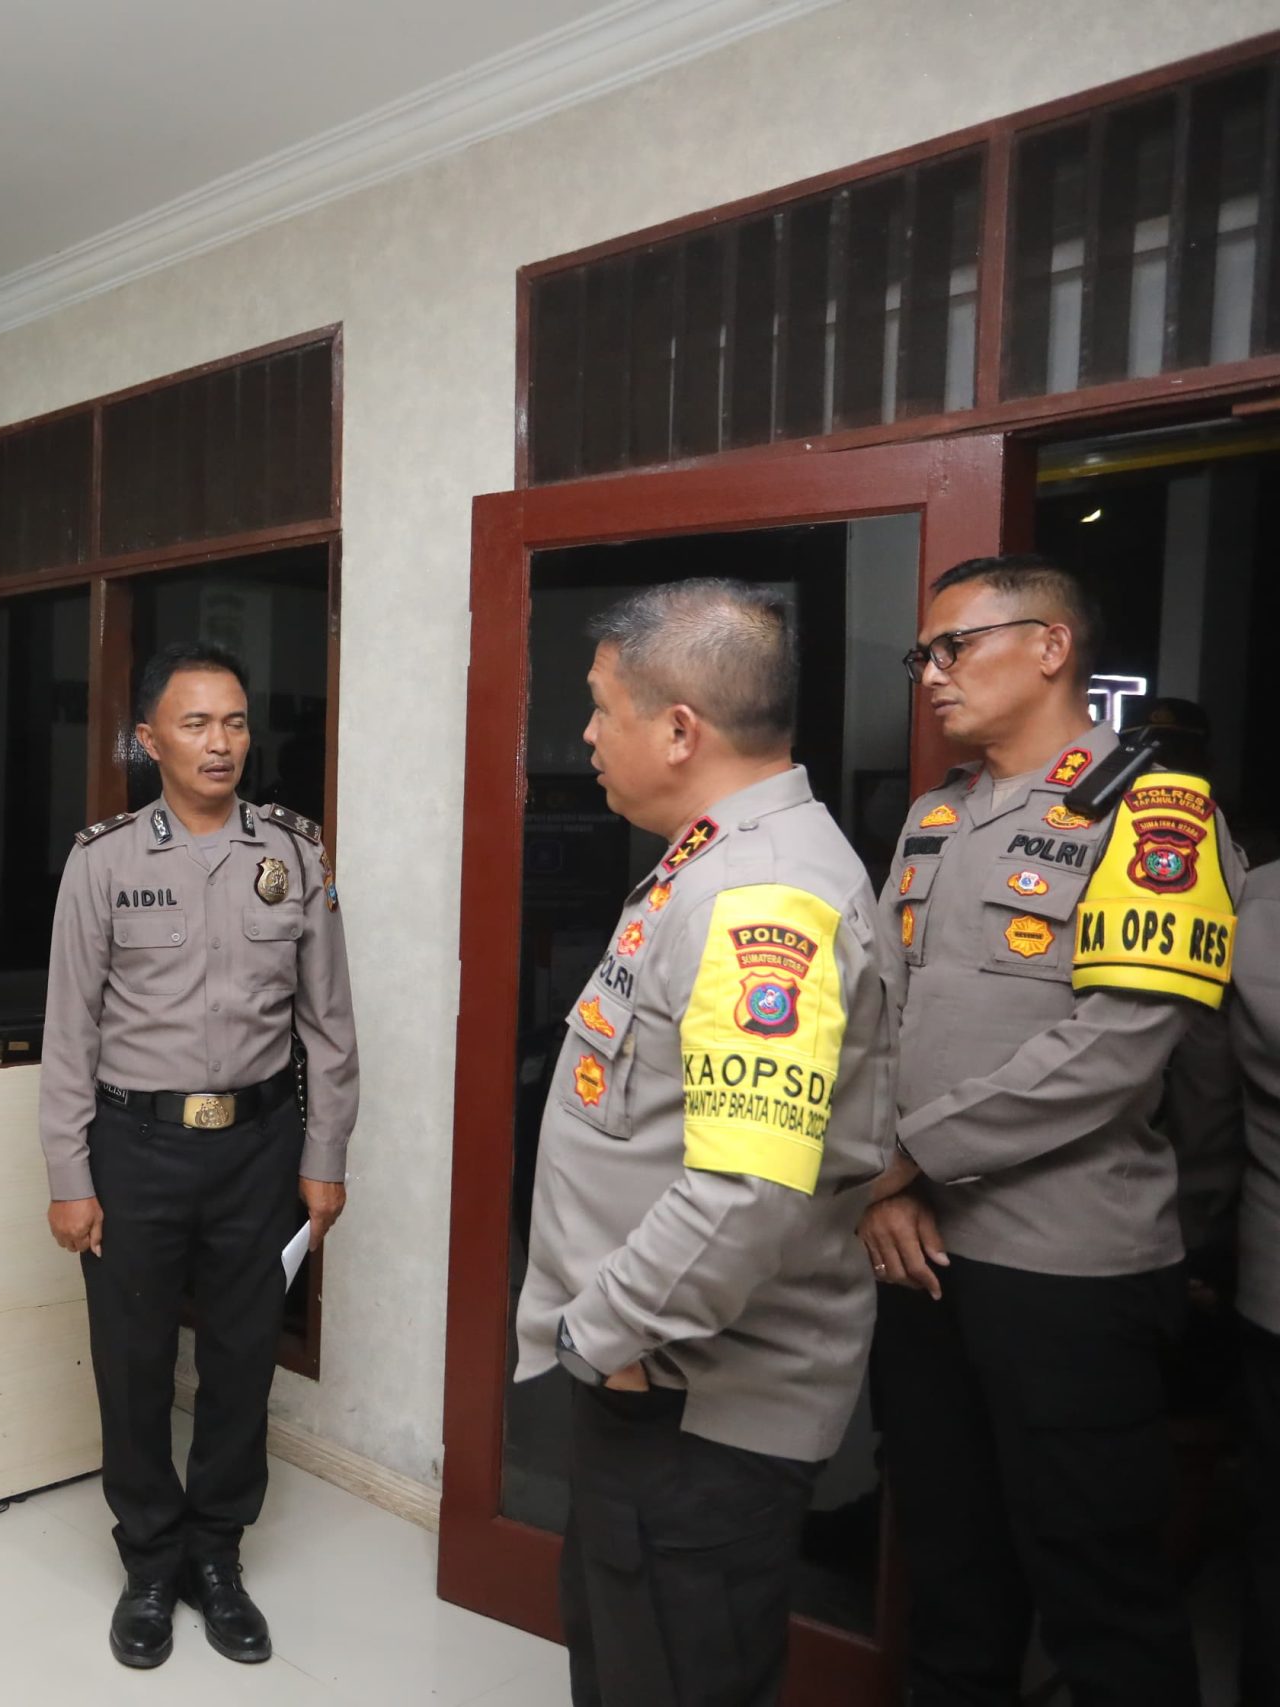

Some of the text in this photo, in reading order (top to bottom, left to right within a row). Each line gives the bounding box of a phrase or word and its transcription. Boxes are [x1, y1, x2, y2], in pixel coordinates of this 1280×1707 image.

[1136, 788, 1205, 806] POLRES
[1007, 834, 1088, 867] POLRI
[116, 888, 177, 908] AIDIL
[738, 928, 810, 956] POLDA
[1080, 909, 1228, 967] KA OPS RES
[599, 950, 634, 999] OLRI
[728, 1092, 768, 1124] BRATA
[772, 1098, 804, 1135] TOBA
